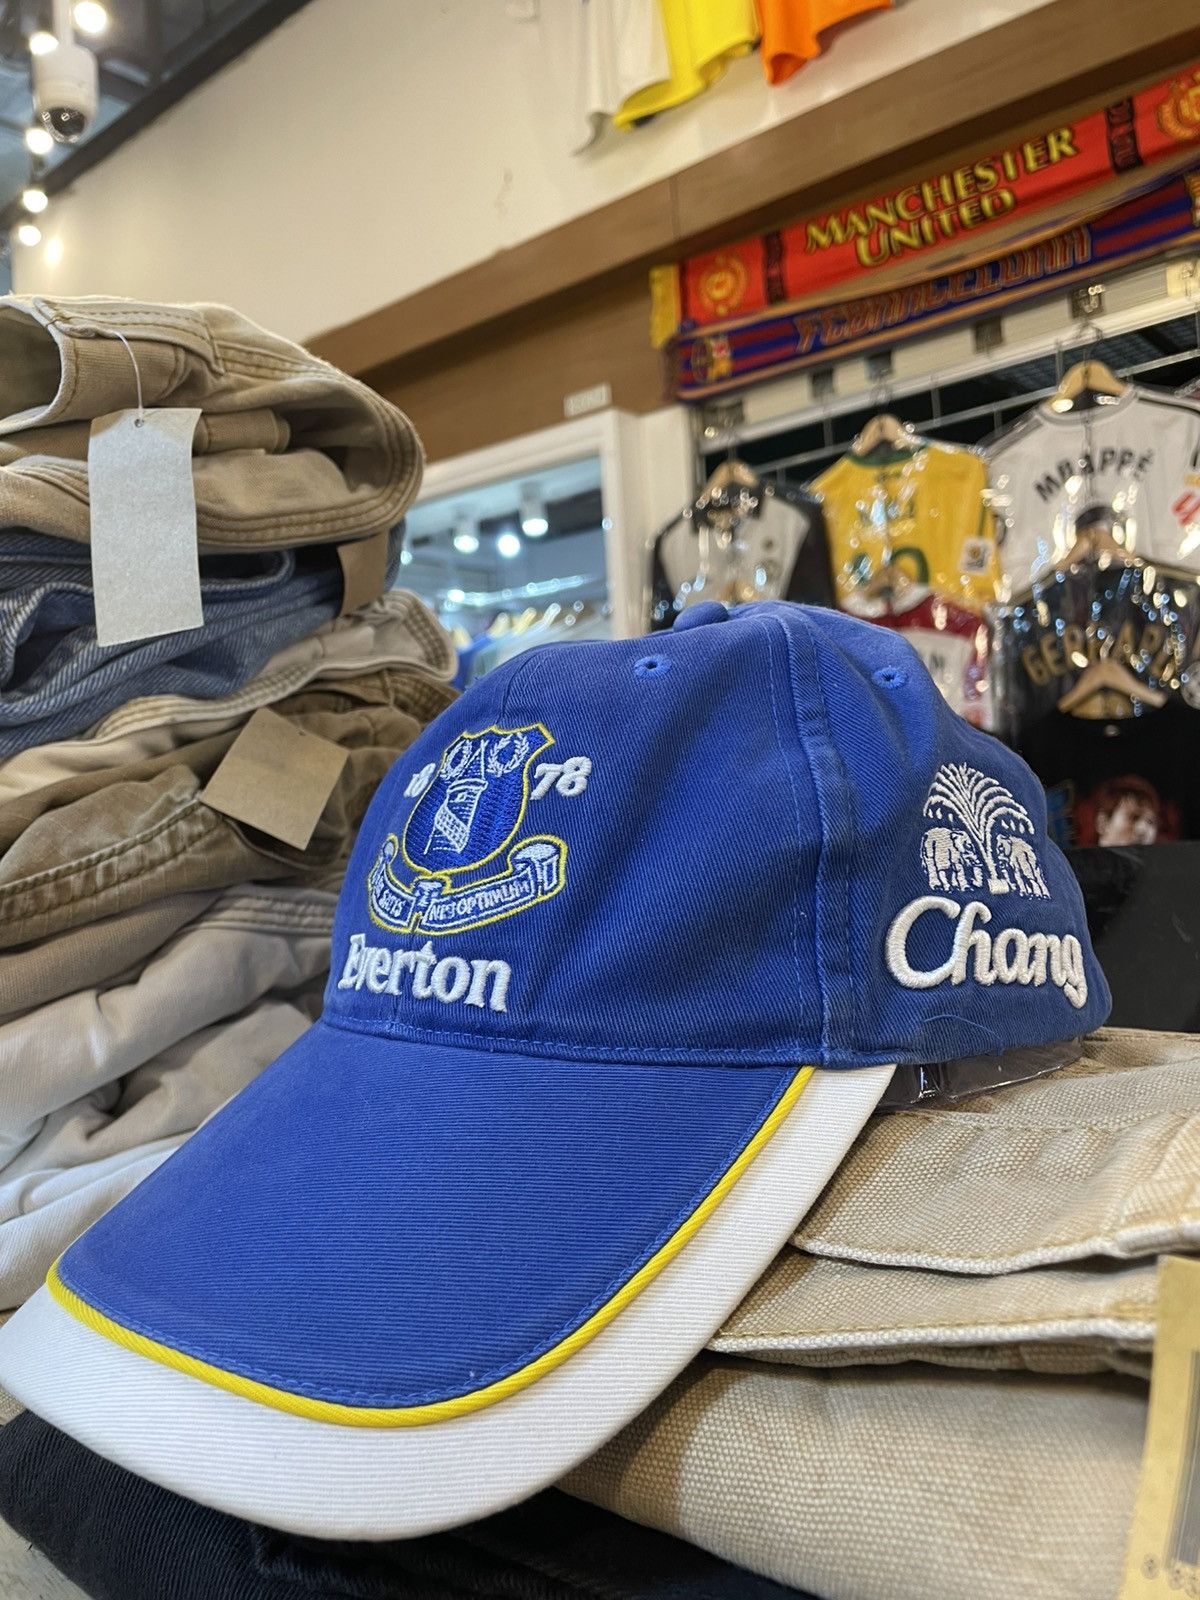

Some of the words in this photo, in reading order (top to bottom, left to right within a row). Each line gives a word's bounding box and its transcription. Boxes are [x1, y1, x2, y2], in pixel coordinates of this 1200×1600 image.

[806, 126, 1079, 254] MANCHESTER
[856, 188, 1015, 268] UNITED
[530, 756, 594, 800] 78
[337, 932, 513, 1013] Everton
[885, 895, 1089, 1009] Chang
